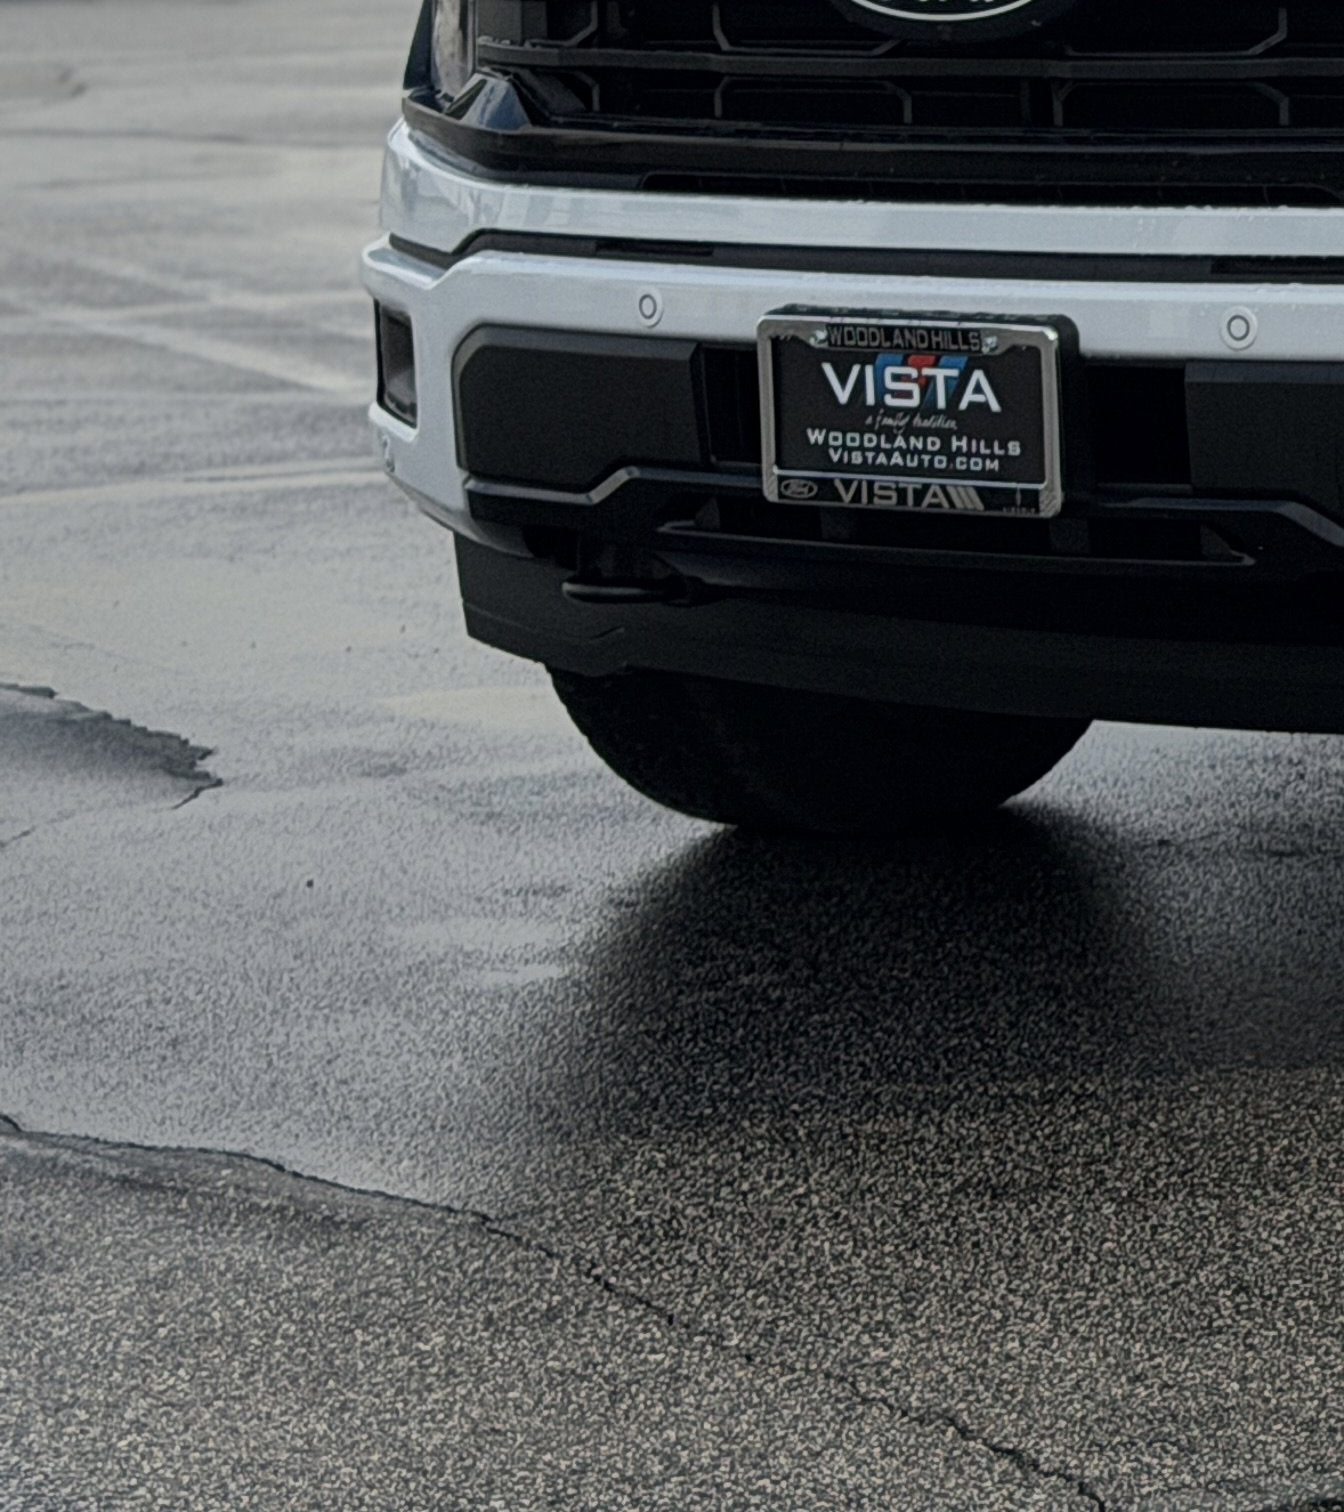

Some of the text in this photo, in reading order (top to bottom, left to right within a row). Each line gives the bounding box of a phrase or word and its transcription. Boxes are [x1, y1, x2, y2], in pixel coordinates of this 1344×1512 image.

[827, 325, 981, 351] WOODLAND HILLS
[822, 361, 1002, 413] VISTA
[806, 428, 1022, 457] WOODLAND HILLS
[834, 479, 951, 510] VISTA
